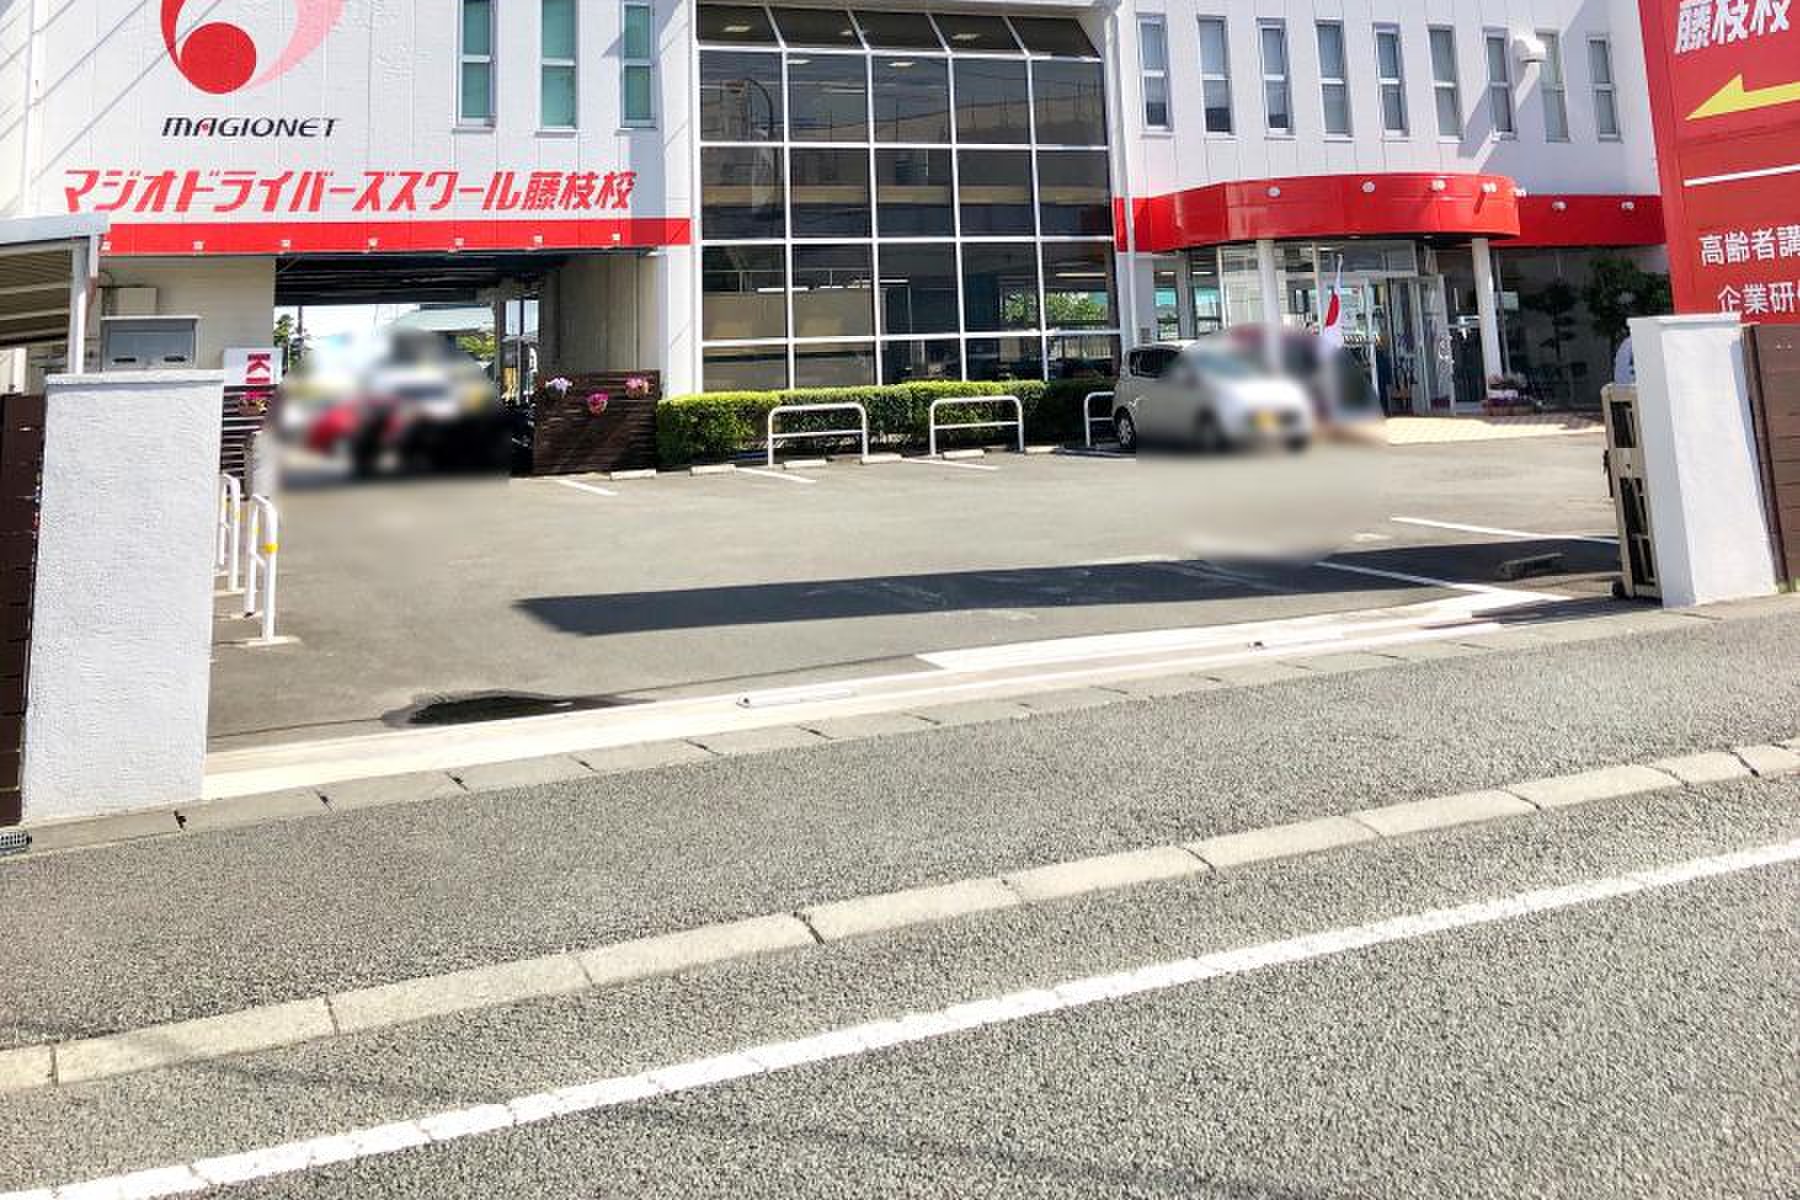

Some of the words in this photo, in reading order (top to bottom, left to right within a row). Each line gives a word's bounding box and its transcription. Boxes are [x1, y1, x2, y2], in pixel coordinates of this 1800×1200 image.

[162, 117, 340, 138] MAGIONET
[64, 169, 637, 213] マジオドライバーズスクール藤枝校
[1717, 279, 1800, 314] 企業研
